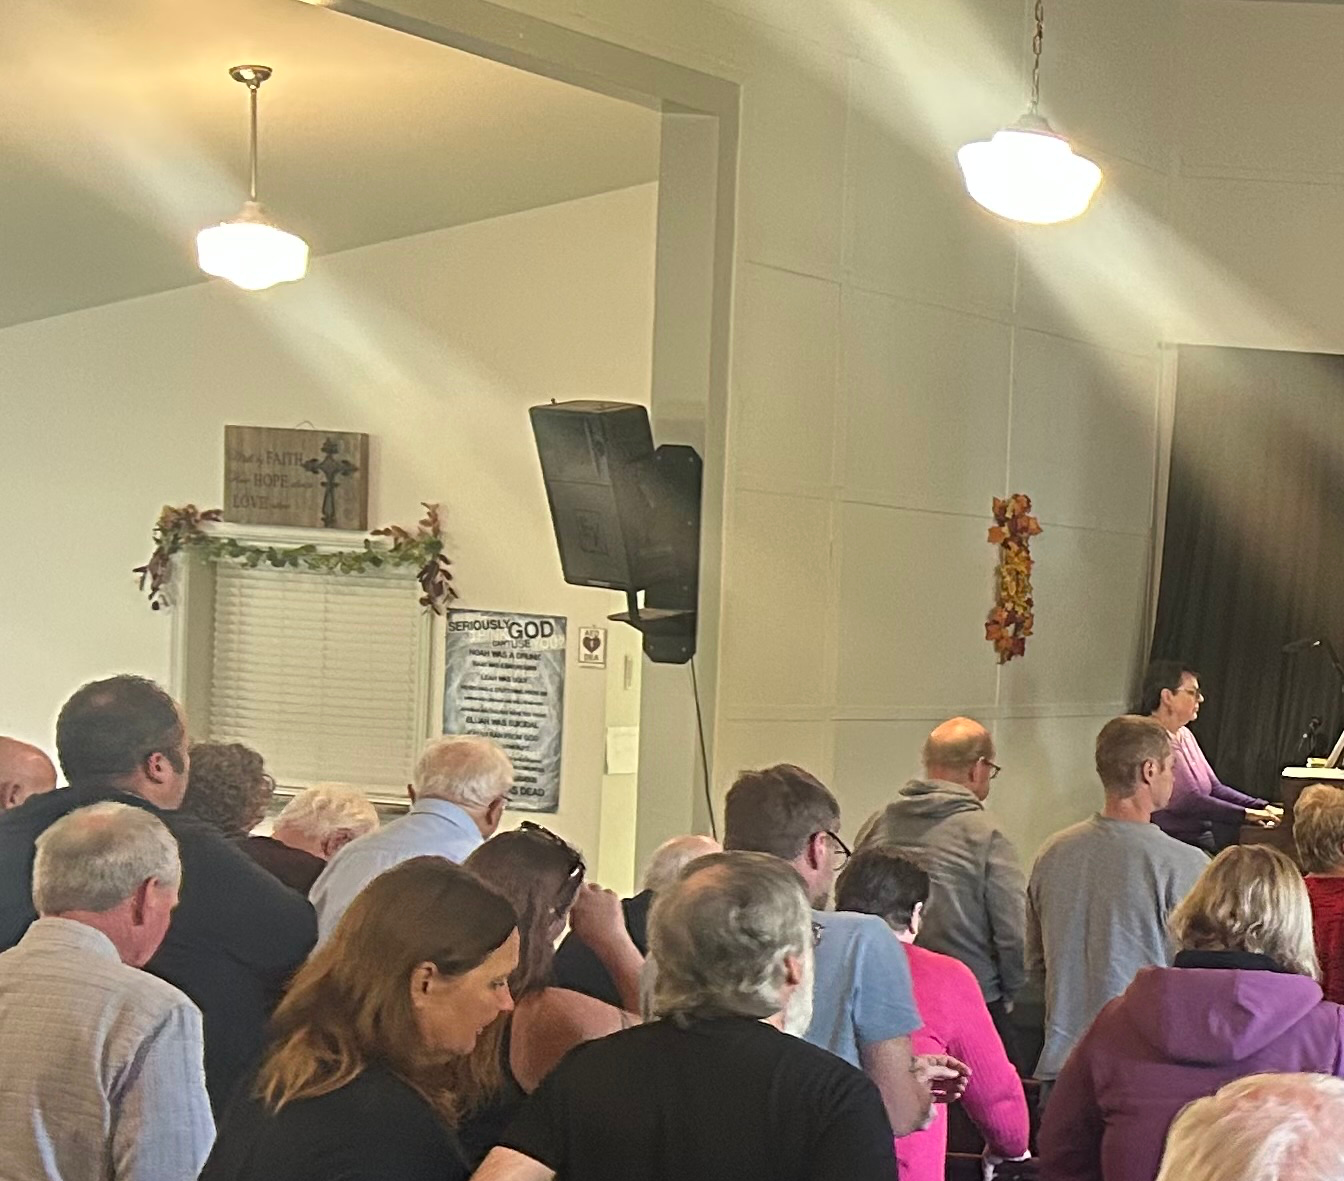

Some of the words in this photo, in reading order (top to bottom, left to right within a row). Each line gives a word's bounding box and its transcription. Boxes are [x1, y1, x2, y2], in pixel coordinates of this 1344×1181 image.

[266, 451, 303, 466] FAITH
[254, 473, 289, 489] HOPE
[233, 495, 268, 509] LOVE
[448, 619, 510, 632] SERIOUSLY
[508, 620, 555, 640] GOD
[511, 640, 531, 648] USE
[520, 786, 546, 797] DEAD
